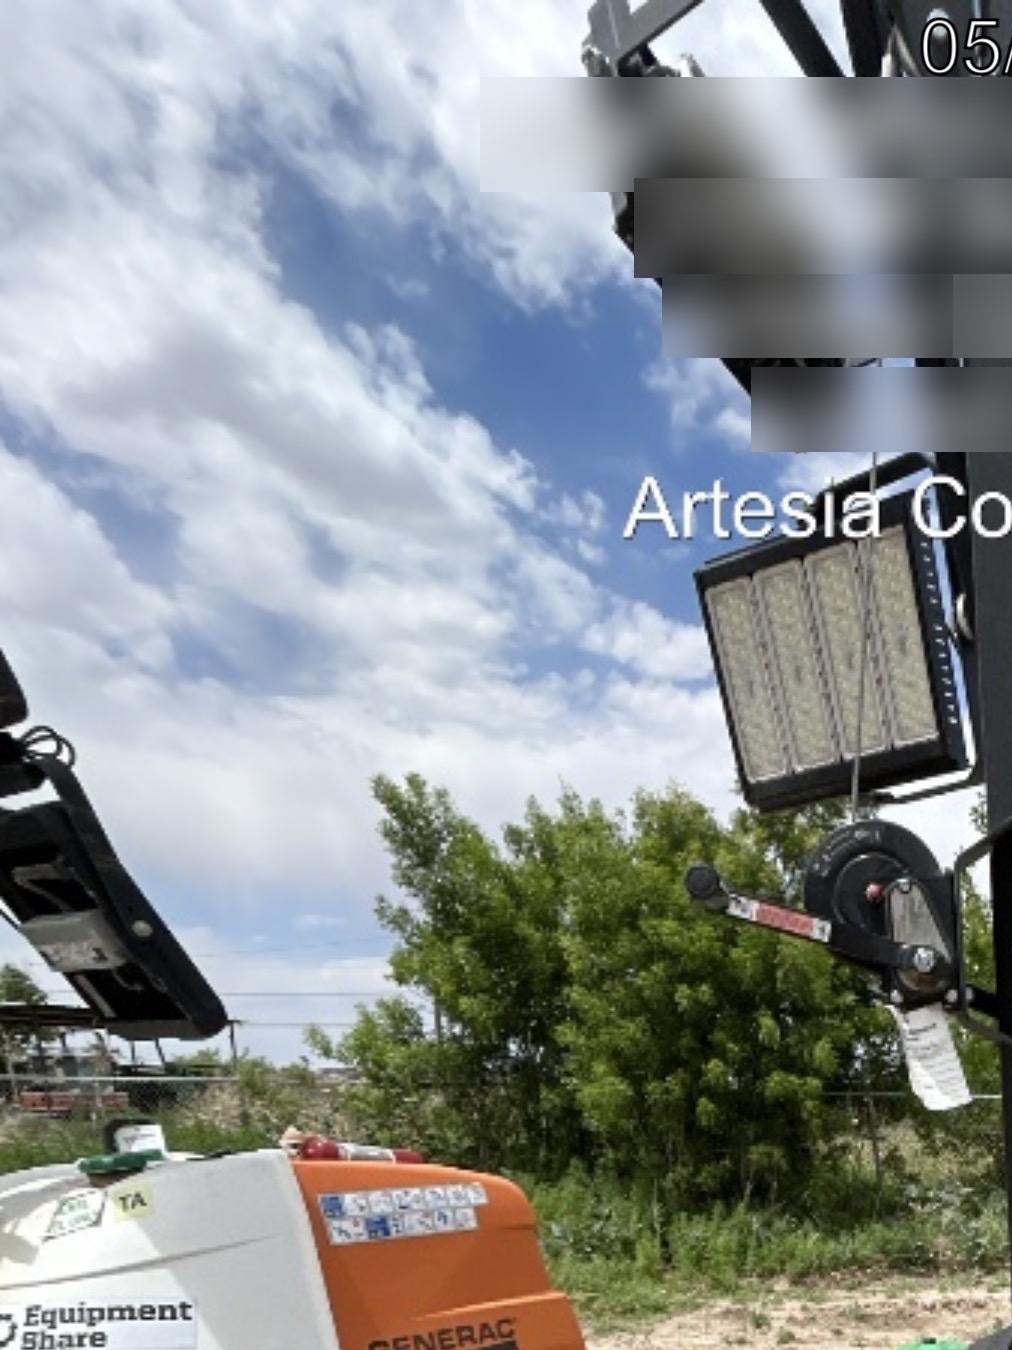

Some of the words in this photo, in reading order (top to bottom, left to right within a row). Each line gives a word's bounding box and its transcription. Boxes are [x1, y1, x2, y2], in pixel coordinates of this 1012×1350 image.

[118, 1191, 148, 1212] TA
[23, 1301, 193, 1329] Equipment
[20, 1330, 107, 1350] Share
